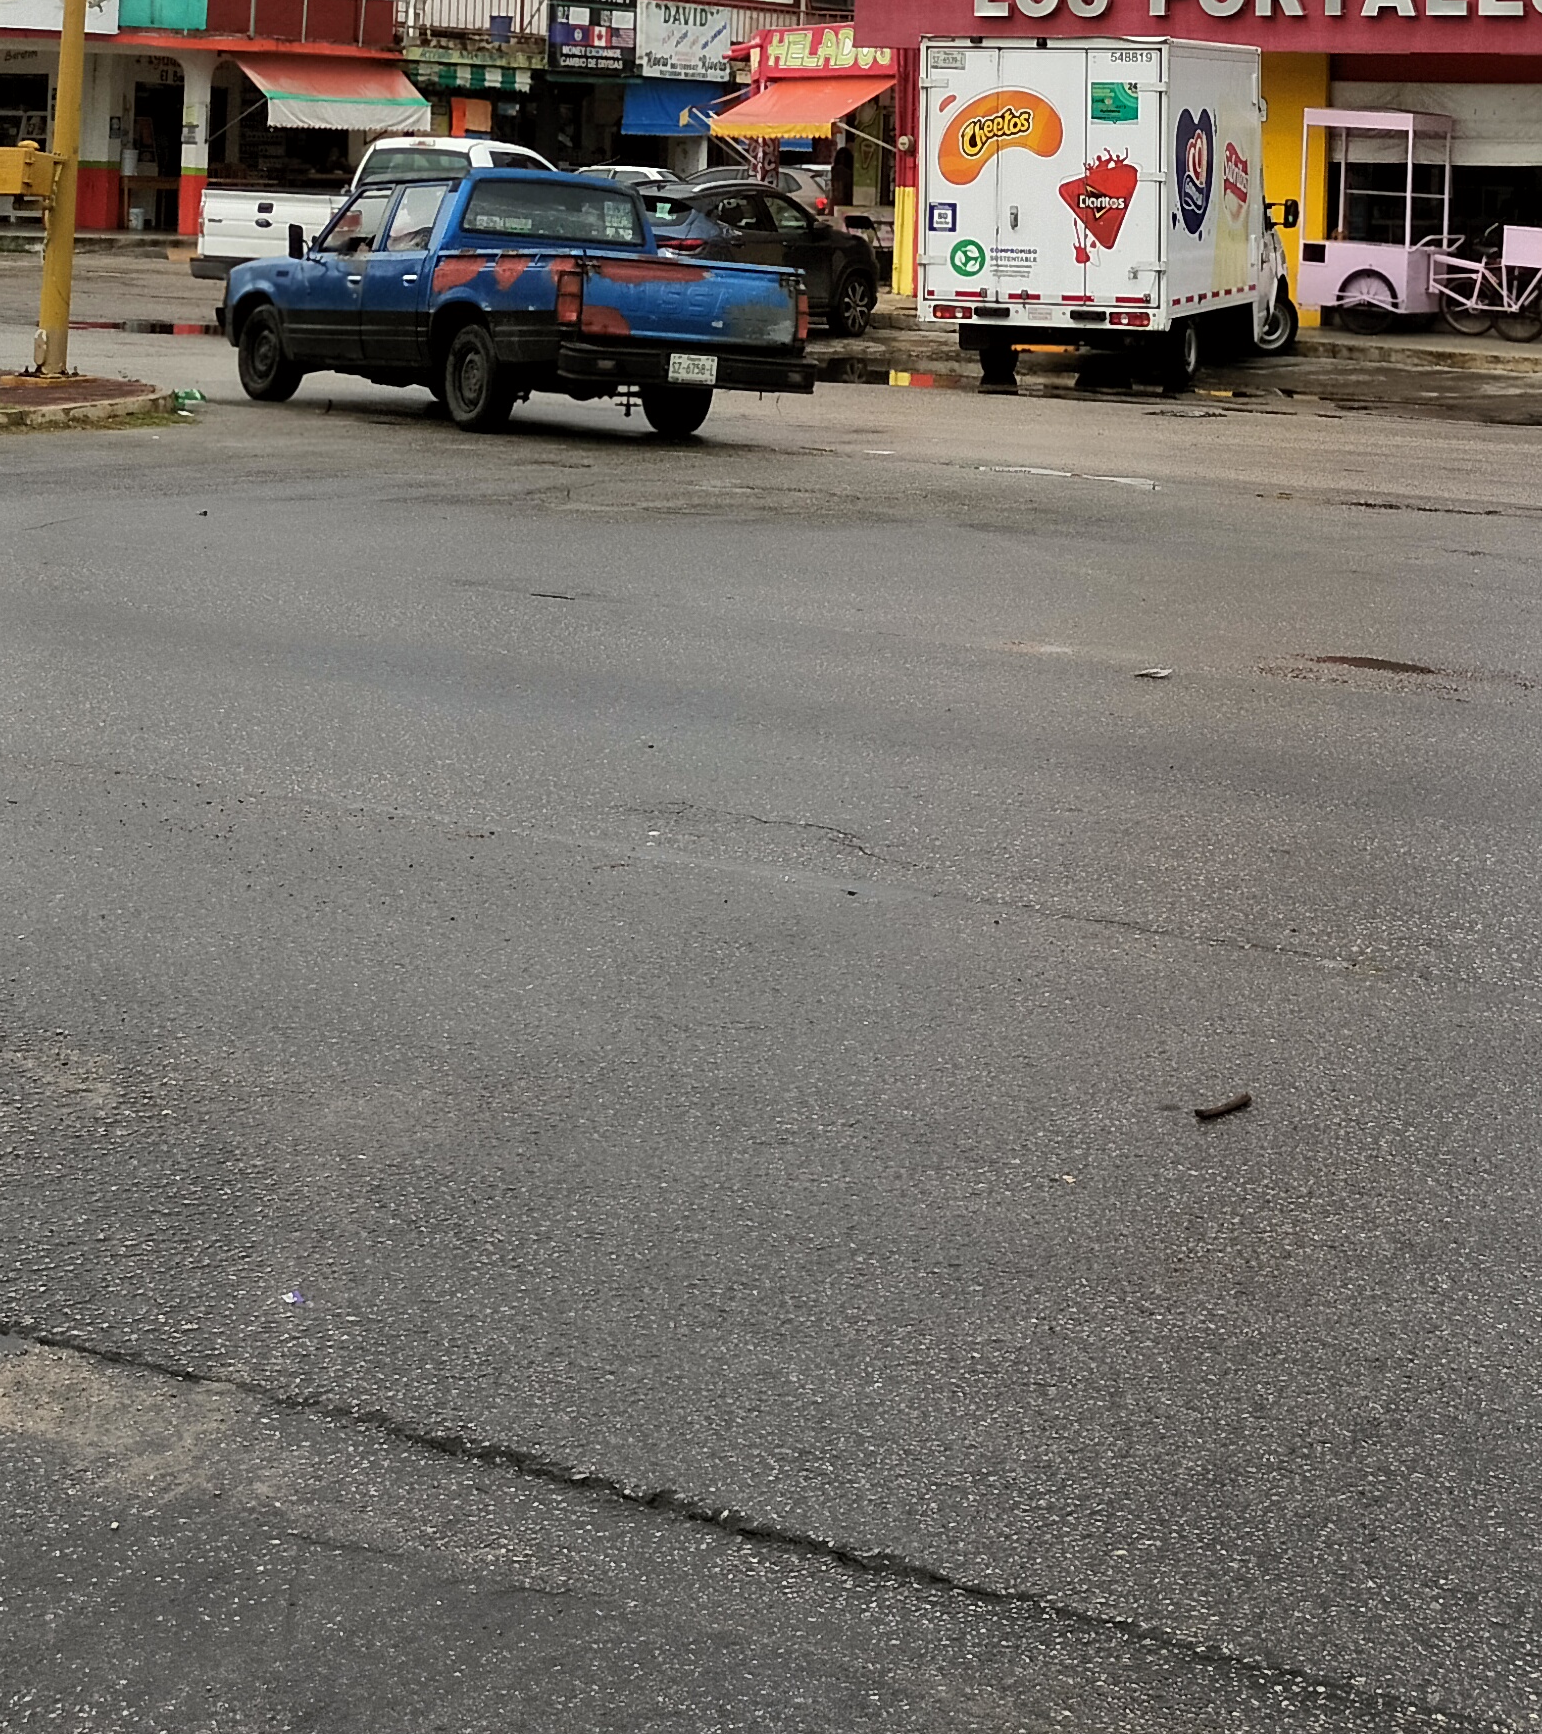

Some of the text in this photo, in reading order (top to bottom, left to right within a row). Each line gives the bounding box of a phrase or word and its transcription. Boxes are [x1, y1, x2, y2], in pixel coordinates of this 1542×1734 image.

[1110, 51, 1153, 63] 548819
[961, 106, 1033, 157] Cheetos
[1079, 195, 1125, 209] Doritos
[989, 247, 1038, 255] COMPROMISO
[989, 255, 1038, 263] SUSTENTABLE
